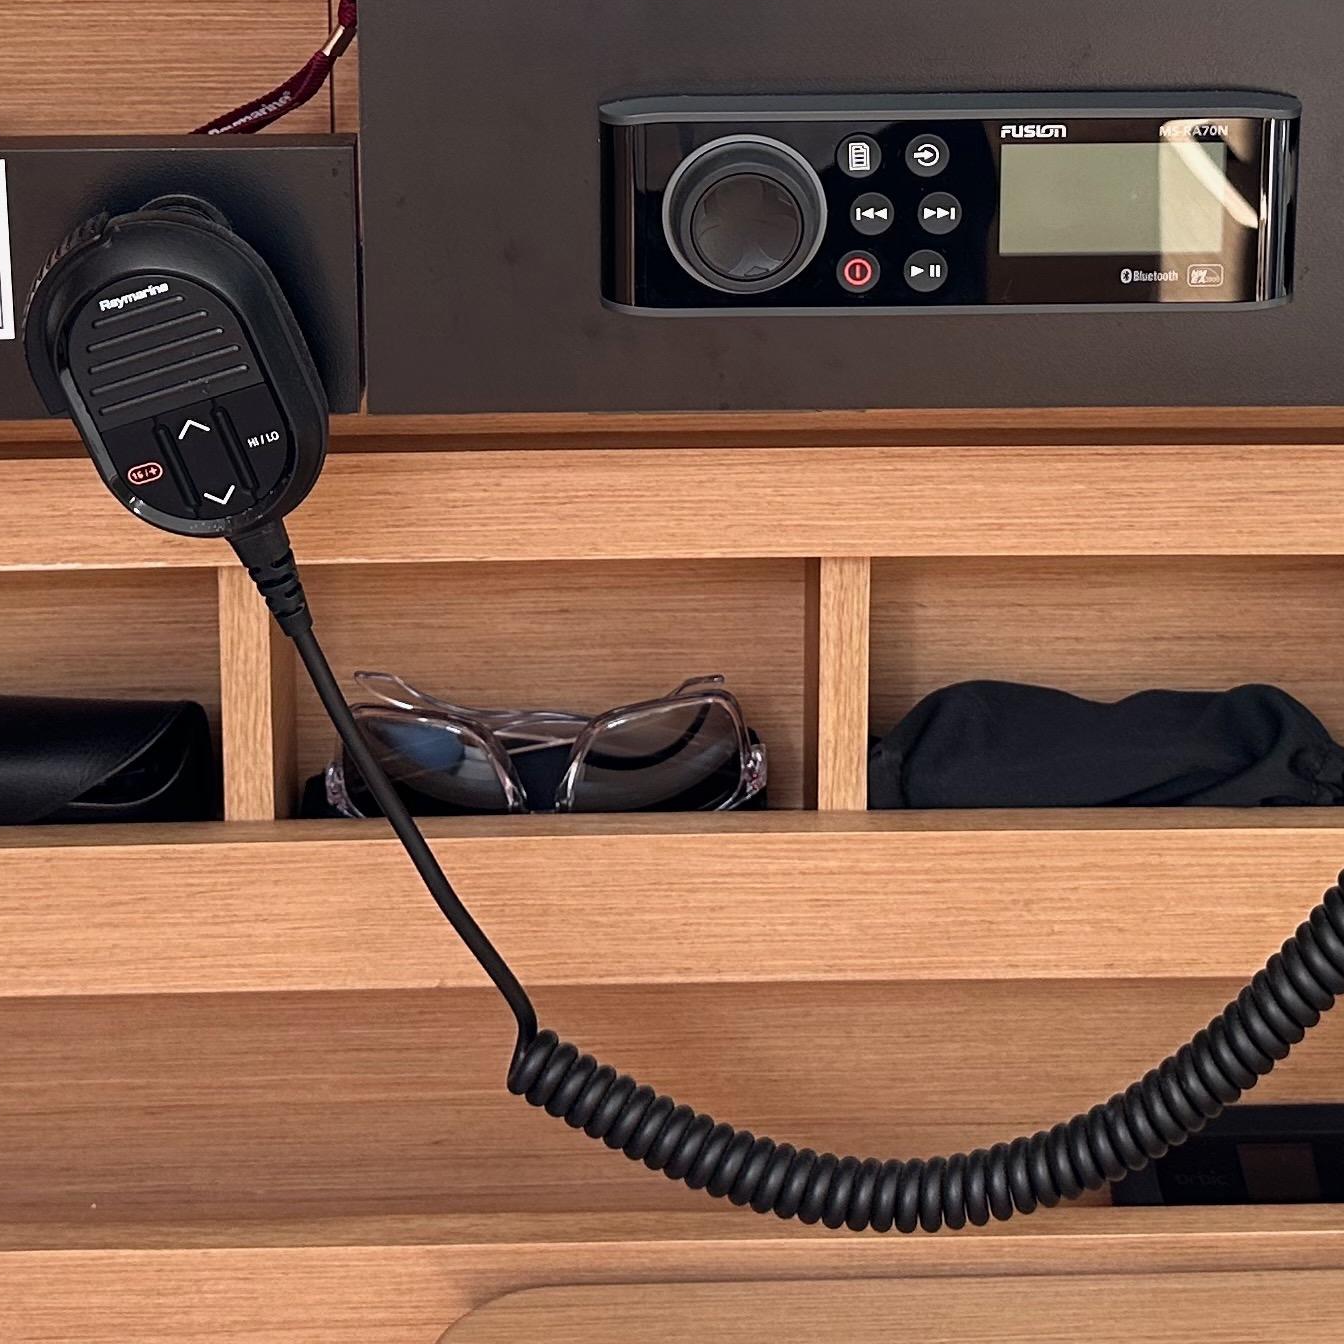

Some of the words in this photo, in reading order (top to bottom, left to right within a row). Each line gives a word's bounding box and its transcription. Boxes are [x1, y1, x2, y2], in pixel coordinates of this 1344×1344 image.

[1000, 124, 1067, 139] FUSION
[1159, 125, 1229, 137] MSRA70N
[1133, 270, 1179, 282] Bluetooth
[99, 281, 170, 312] Raymarine
